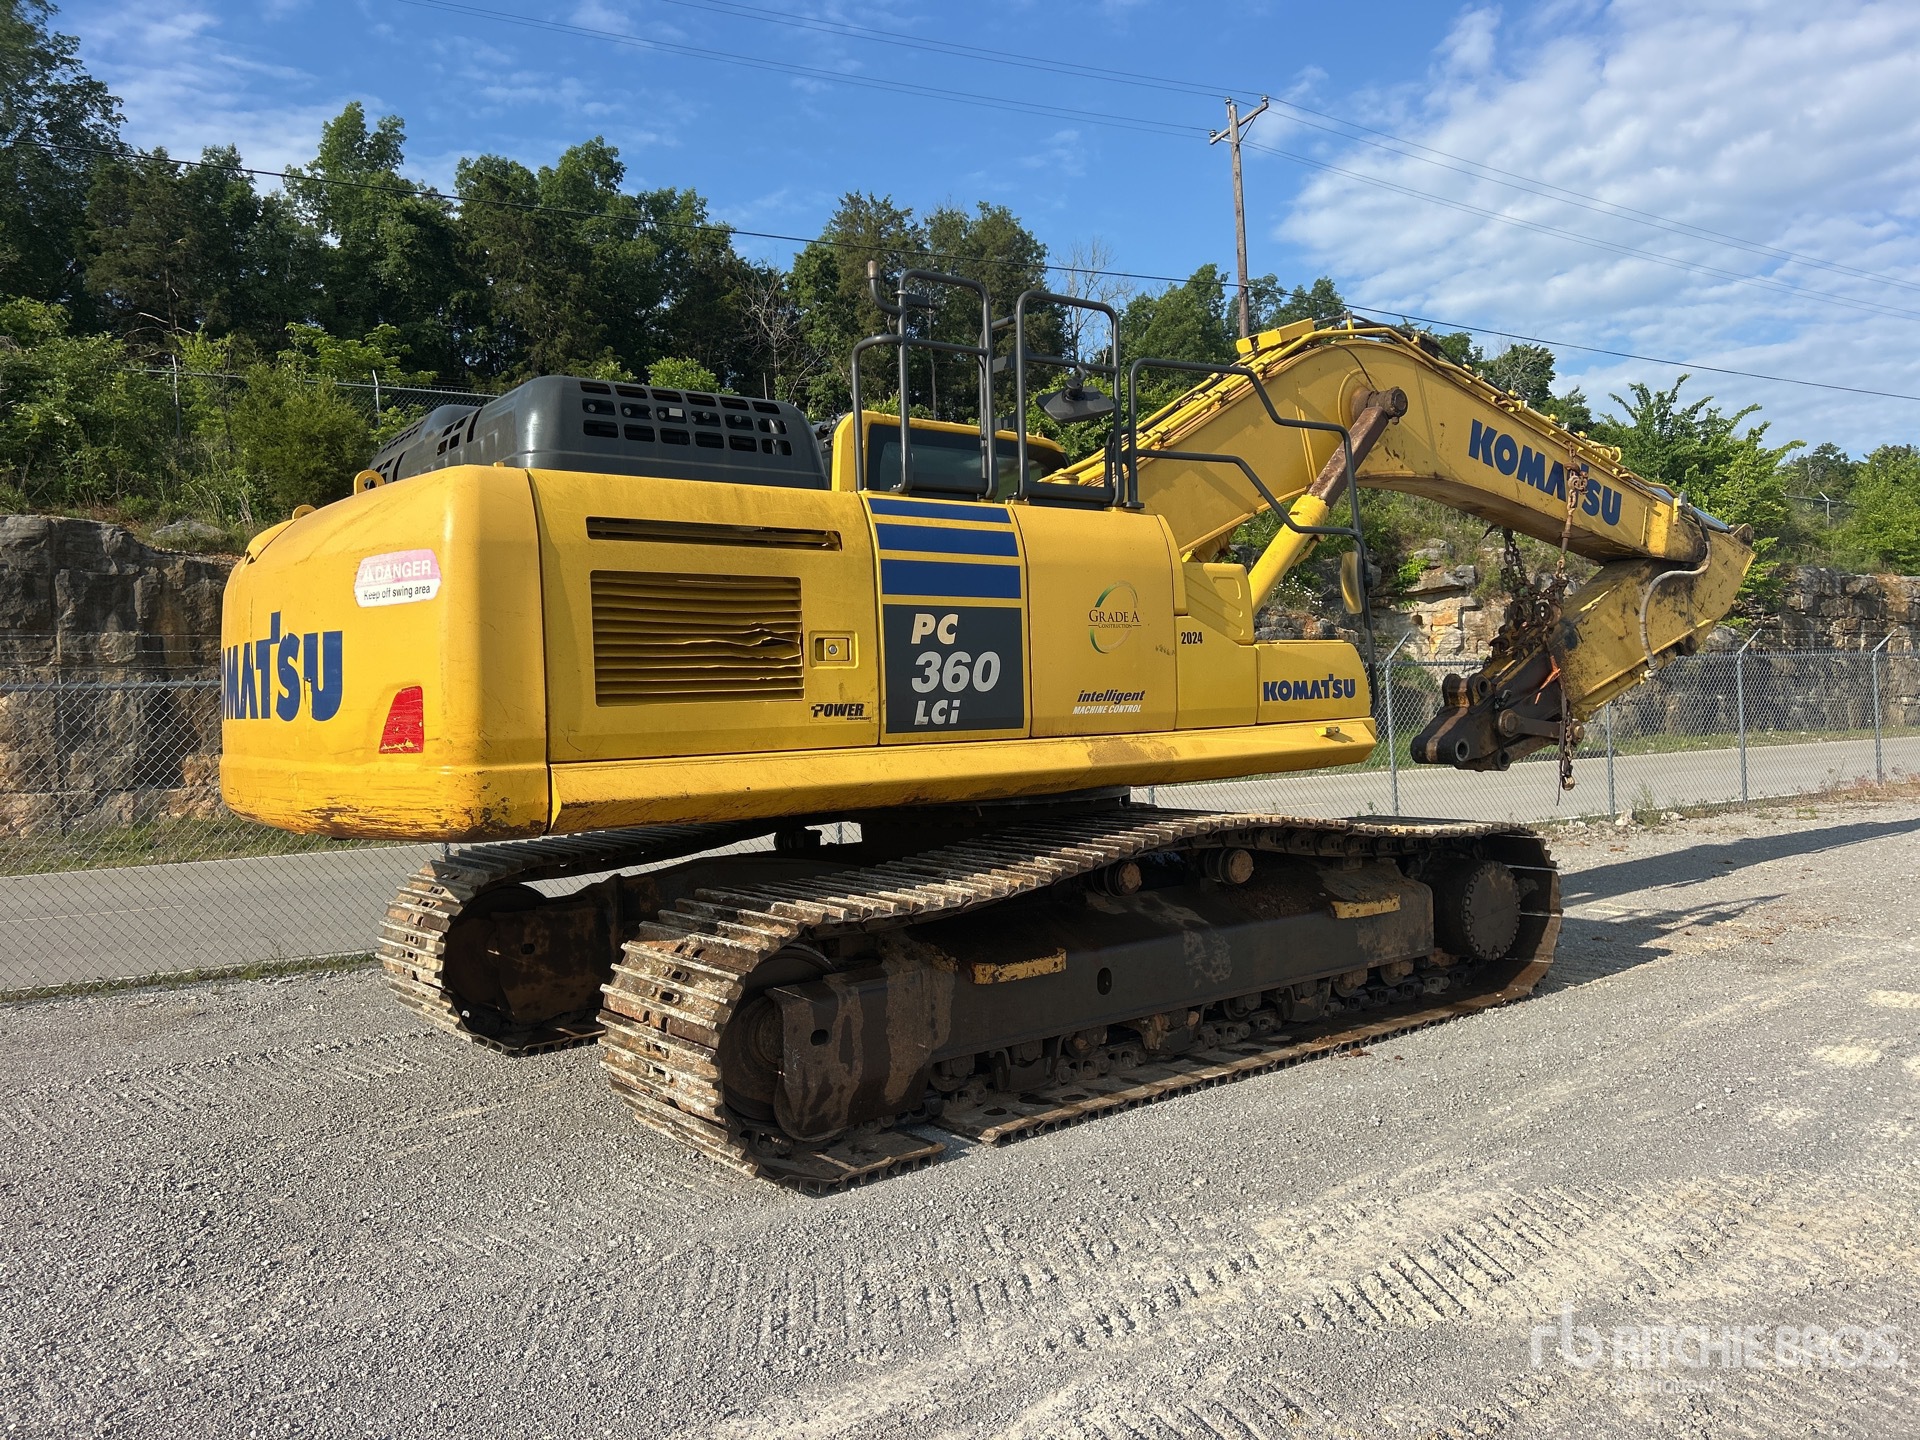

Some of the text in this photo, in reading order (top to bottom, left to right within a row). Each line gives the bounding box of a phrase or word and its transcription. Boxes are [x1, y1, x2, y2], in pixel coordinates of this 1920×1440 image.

[375, 559, 432, 580] DANGER
[363, 585, 431, 602] Keep off swing area
[1088, 609, 1140, 623] GRADE A
[911, 613, 959, 645] PC
[1180, 631, 1203, 645] 2024
[221, 610, 343, 722] OMATSU
[911, 651, 1001, 694] 360
[1077, 689, 1146, 704] intelligent
[1263, 673, 1356, 702] KOMATSU
[810, 703, 865, 718] POWER
[914, 699, 961, 726] LCi
[1072, 704, 1142, 715] MACHINE CONTROL
